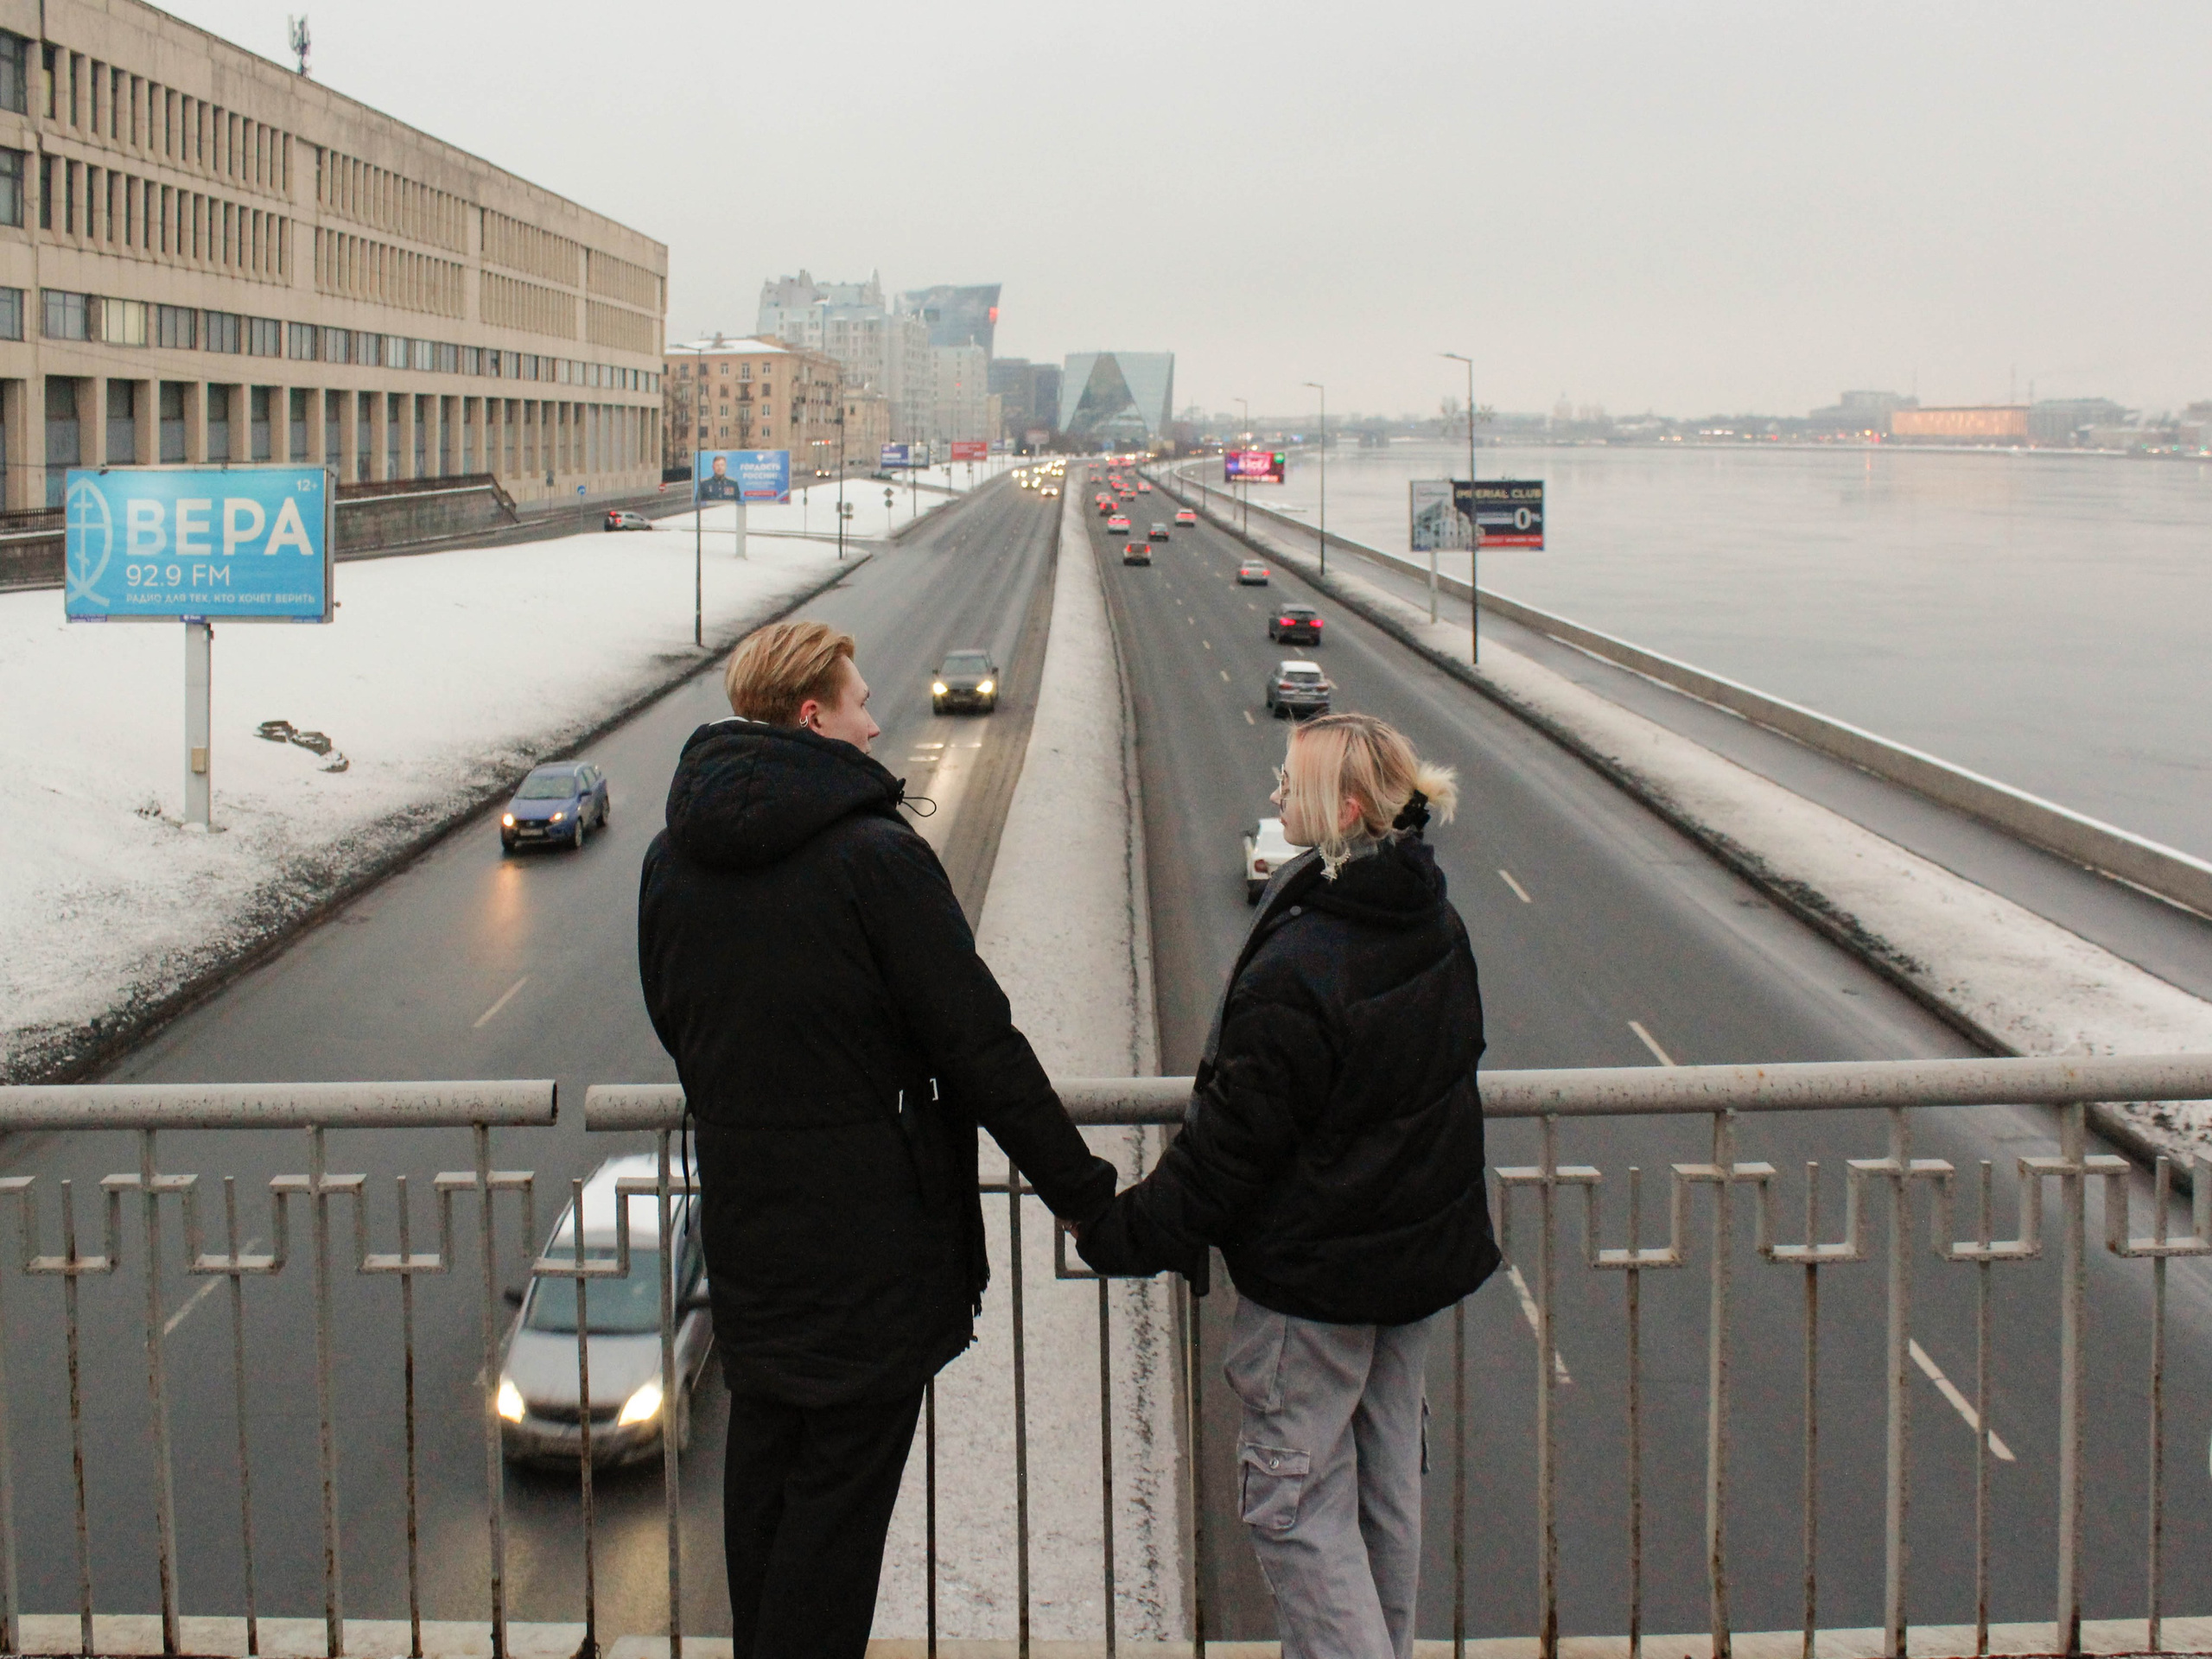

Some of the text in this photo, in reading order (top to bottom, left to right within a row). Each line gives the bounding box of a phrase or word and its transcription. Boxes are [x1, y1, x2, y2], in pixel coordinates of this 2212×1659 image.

[296, 479, 319, 492] 12+
[1510, 489, 1542, 499] CLUB
[126, 497, 315, 556] ВЕРА
[125, 564, 231, 587] 92.9 FM
[126, 594, 315, 604] РАДИО ДЛЯ ТЕХ, КТО ХОЧЕТ ВЕРИТЬ
